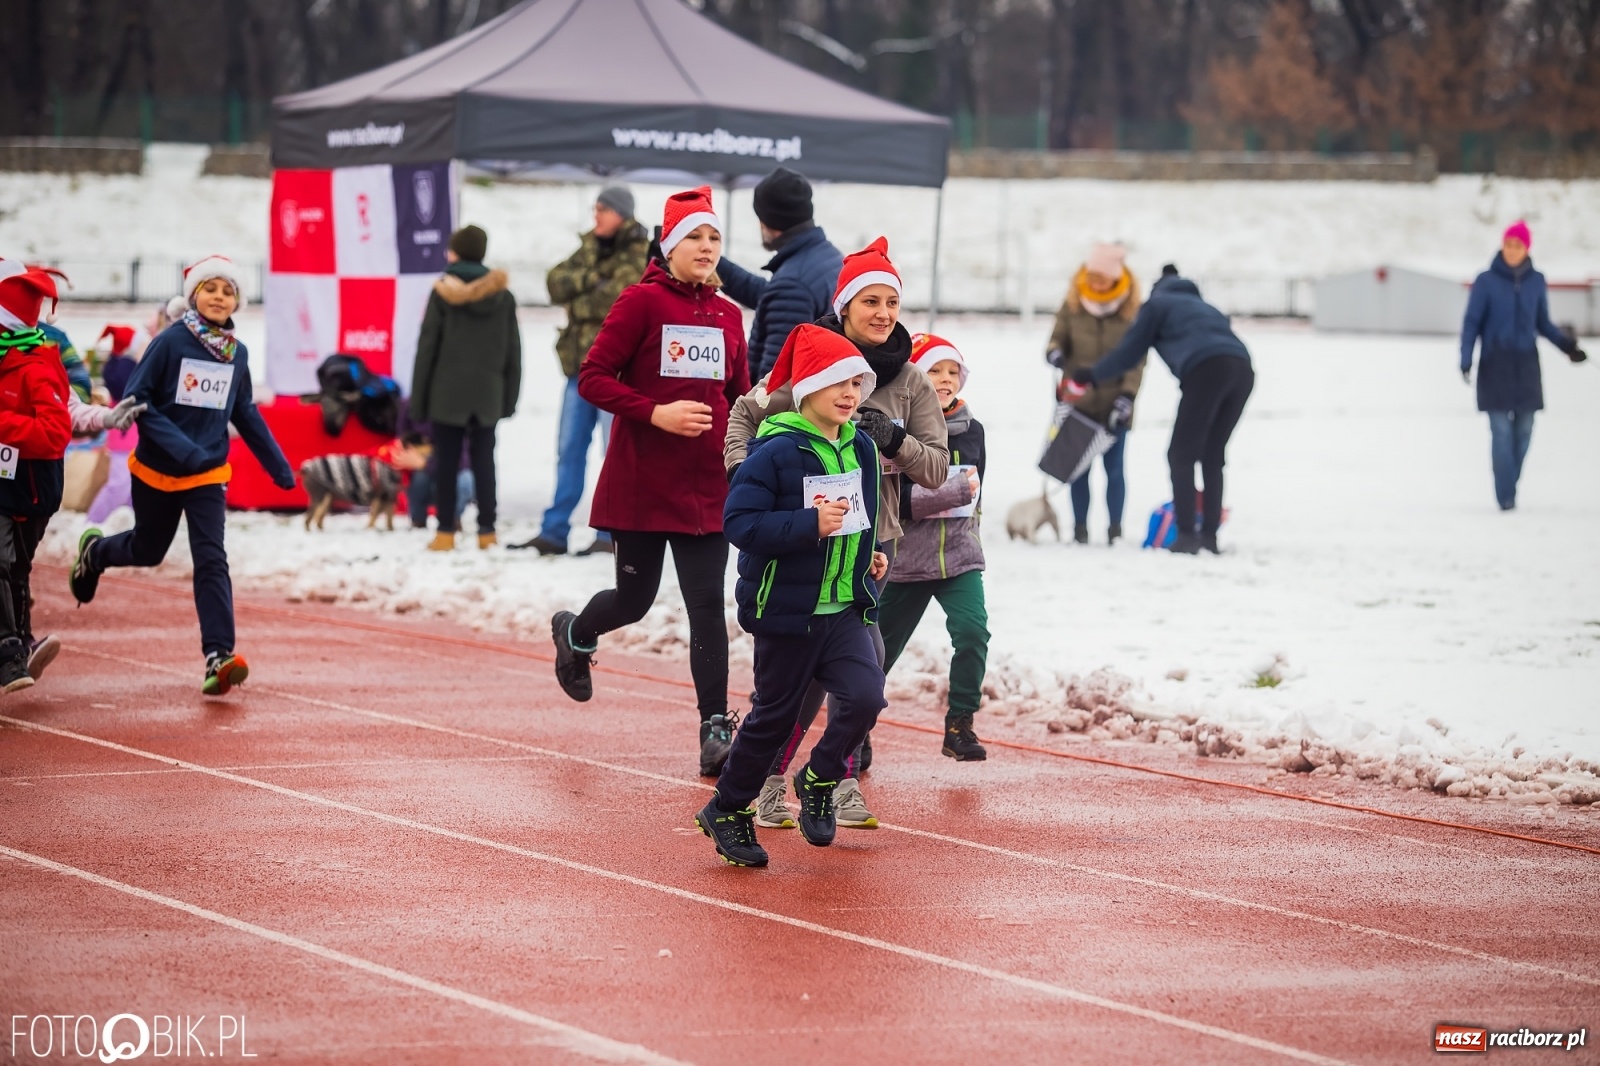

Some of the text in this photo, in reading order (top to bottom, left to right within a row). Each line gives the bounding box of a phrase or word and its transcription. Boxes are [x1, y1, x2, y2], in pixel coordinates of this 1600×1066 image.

[611, 127, 802, 162] www.raciborz.pl
[688, 345, 720, 363] 040
[201, 378, 227, 395] 047
